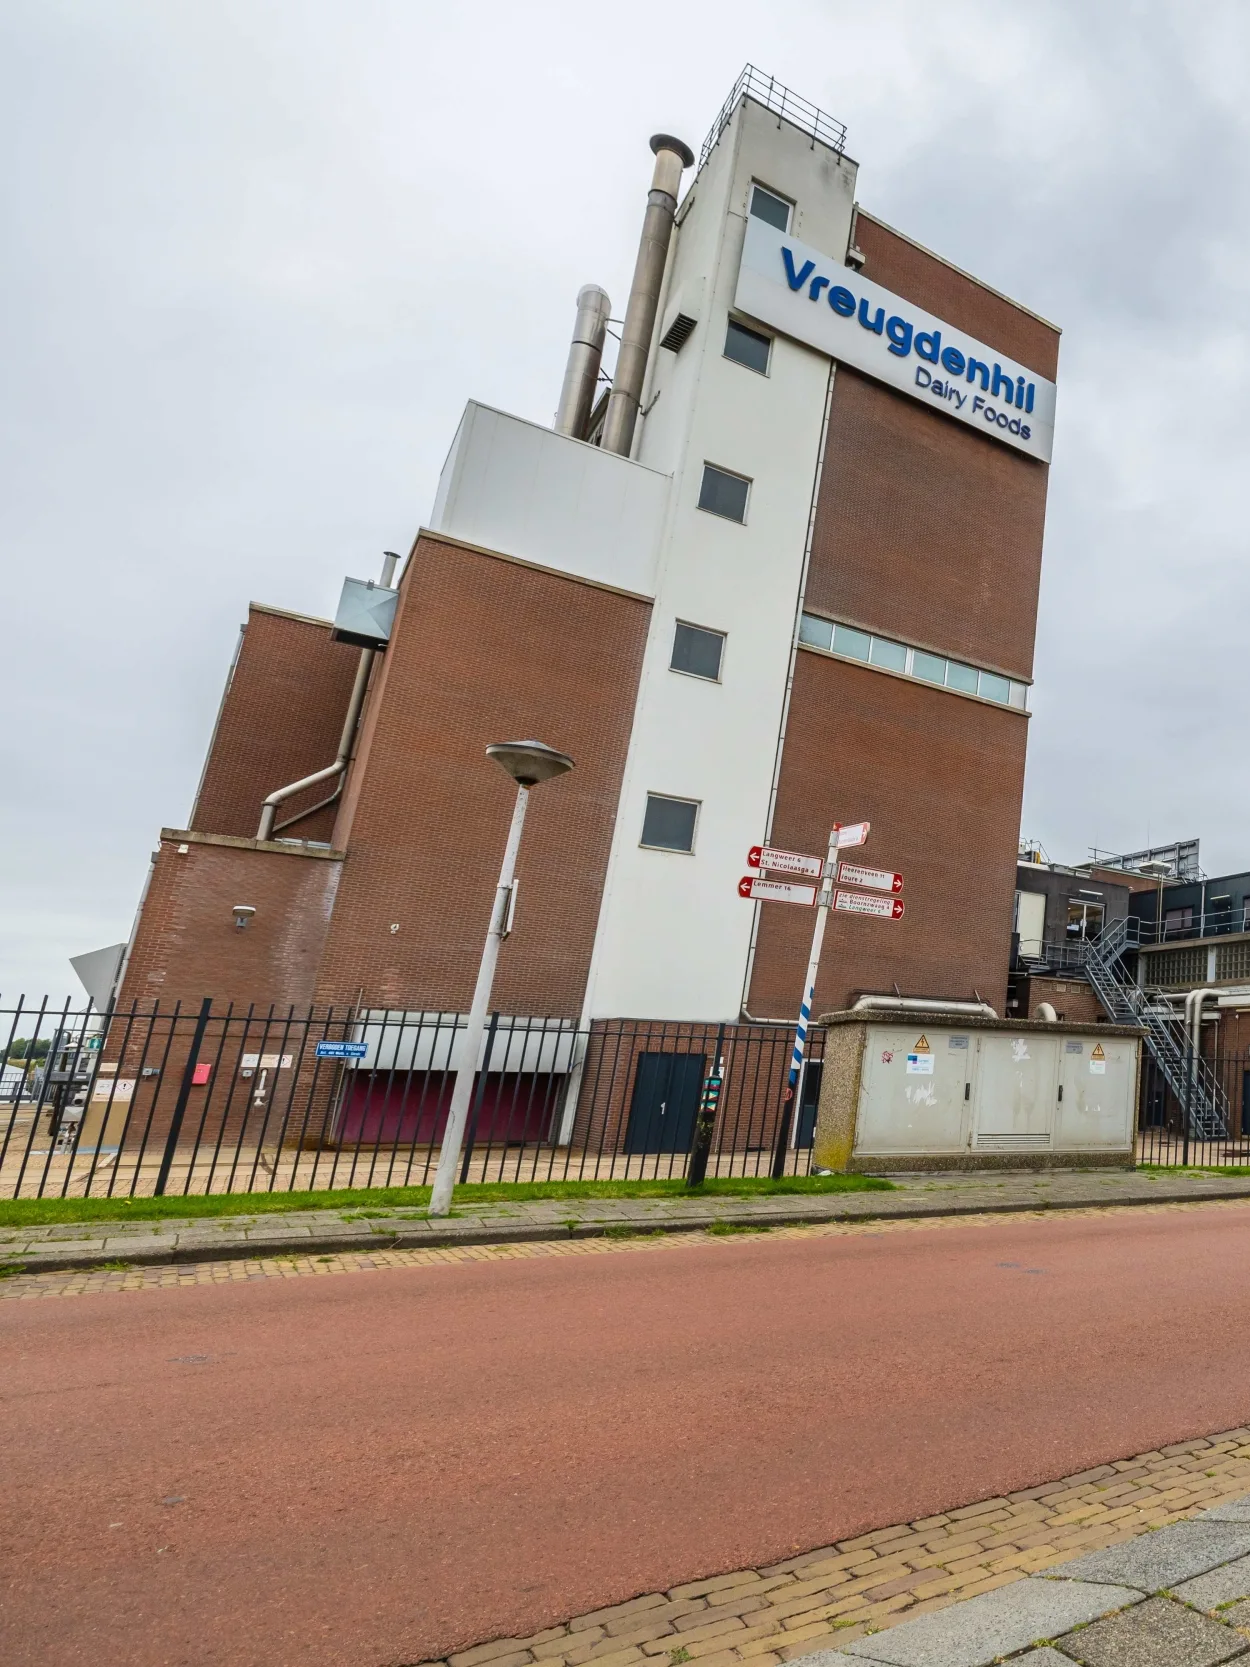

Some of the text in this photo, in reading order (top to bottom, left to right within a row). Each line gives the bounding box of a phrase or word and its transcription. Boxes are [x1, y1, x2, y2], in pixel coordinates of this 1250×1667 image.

[782, 246, 1035, 414] Vreugdenhil
[914, 365, 1031, 439] Dairy Foods
[762, 850, 796, 862] Langweer
[772, 861, 809, 874] Nicolaasga
[753, 880, 782, 891] Lemmer
